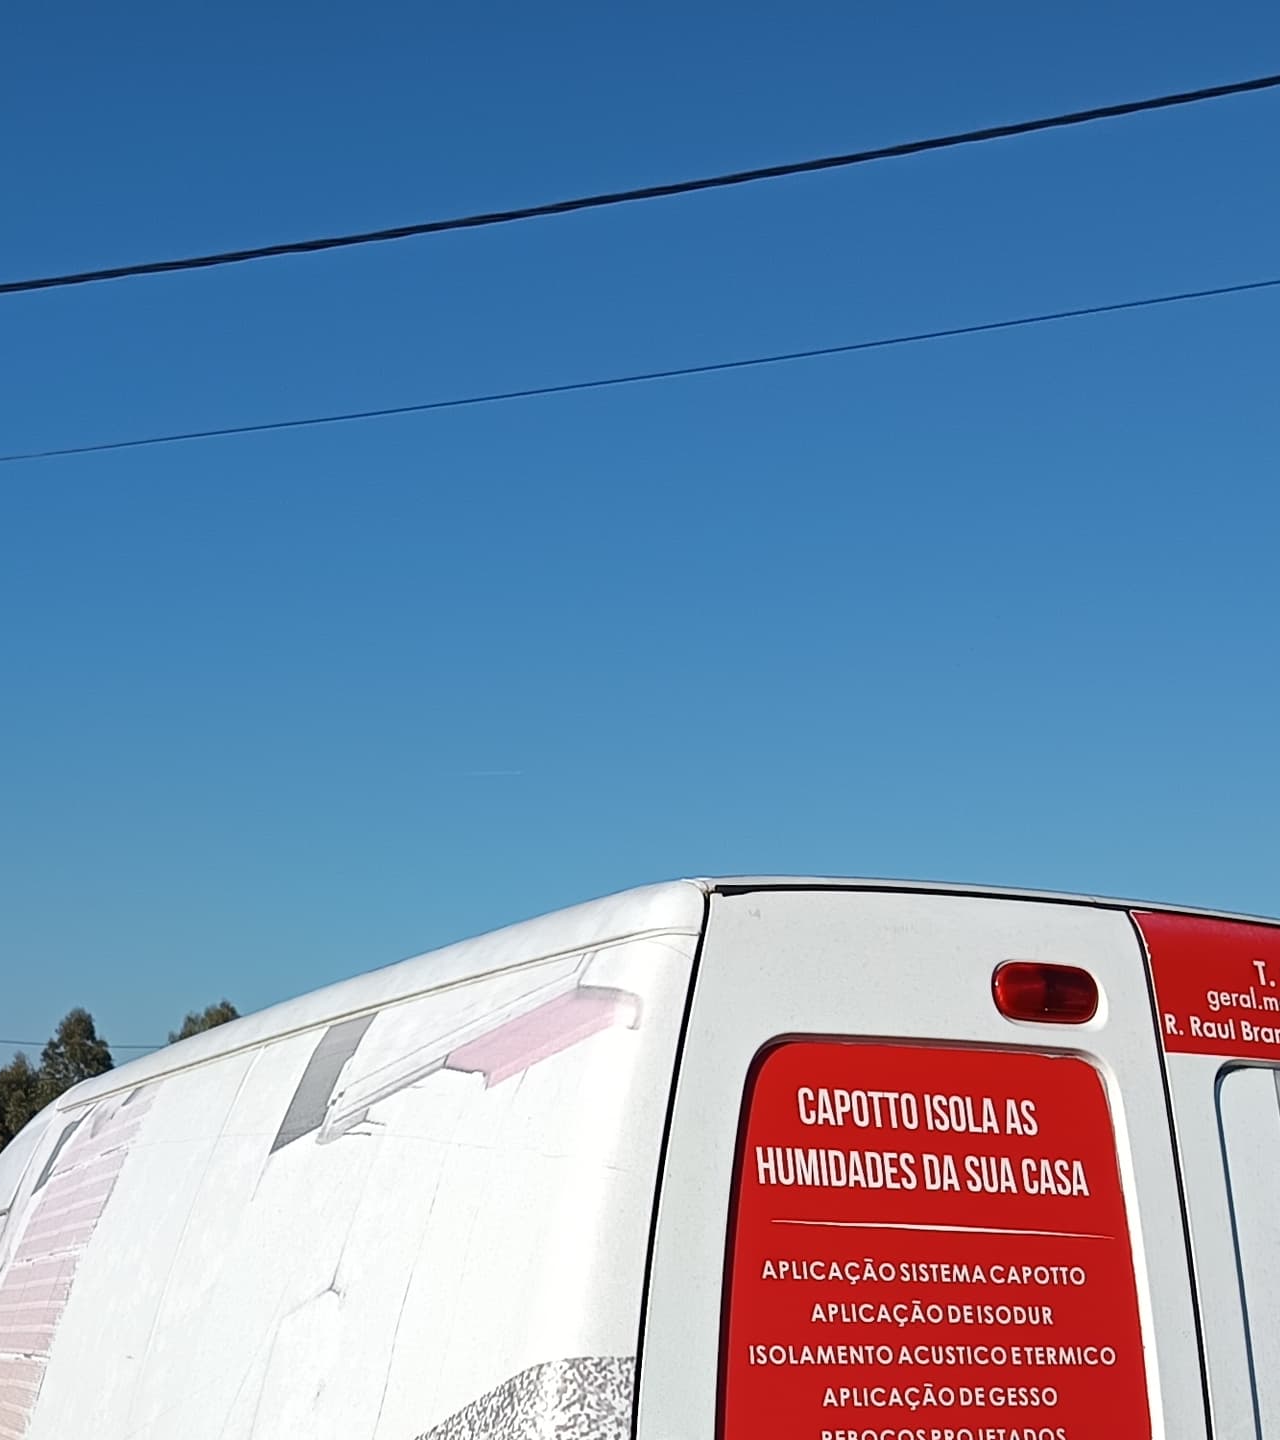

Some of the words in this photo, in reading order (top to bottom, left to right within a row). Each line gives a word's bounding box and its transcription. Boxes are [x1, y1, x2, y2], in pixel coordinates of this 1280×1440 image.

[1253, 960, 1276, 987] T.
[1165, 1014, 1184, 1036] R.
[1191, 1017, 1235, 1040] Raul
[797, 1086, 918, 1131] CAPOTTO
[924, 1094, 1000, 1134] ISOLA
[1006, 1099, 1038, 1136] AS
[756, 1146, 917, 1190] HUMIDADES
[922, 1154, 960, 1191] DA
[965, 1156, 1018, 1193] SUA
[1022, 1159, 1089, 1196] CASA
[762, 1258, 896, 1285] APLICAÇÃO
[900, 1263, 986, 1284] SISTEMA
[990, 1265, 1086, 1286] CAPOTTO
[811, 1300, 942, 1327] APLICAÇÃO
[948, 1305, 974, 1324] DE
[977, 1305, 1054, 1325] ISODUR
[749, 1345, 894, 1365] ISOLAMENTO
[898, 1346, 1007, 1366] ACUSTICO
[1012, 1347, 1022, 1365] E
[1023, 1346, 1116, 1366] TERMICO
[822, 1383, 955, 1411] APLICAÇÃO
[959, 1387, 985, 1407] DE
[989, 1387, 1058, 1407] GESSO
